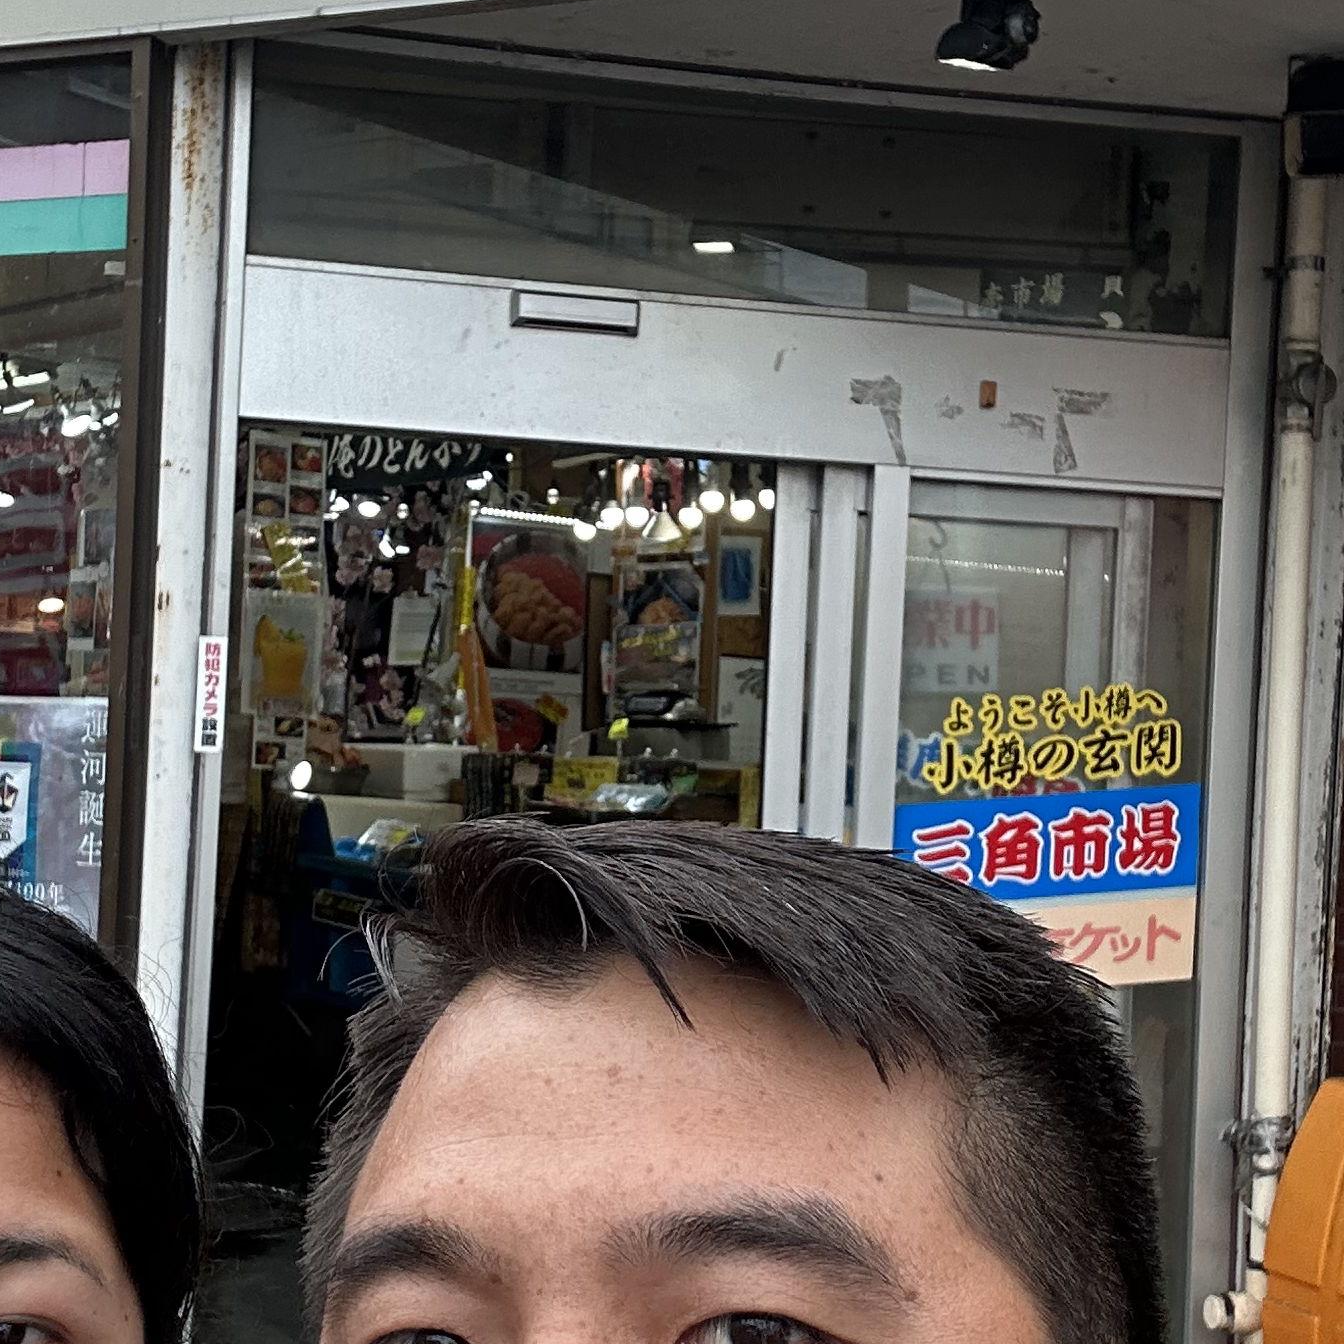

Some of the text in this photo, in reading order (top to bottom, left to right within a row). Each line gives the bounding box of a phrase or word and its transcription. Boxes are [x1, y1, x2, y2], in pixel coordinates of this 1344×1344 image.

[201, 641, 221, 747] 防犯カメラ設置
[946, 686, 1164, 732] ようこそ小樽へ
[76, 710, 108, 867] 運河誕生
[925, 720, 1179, 789] 小樽の玄関
[913, 800, 1180, 888] 三角市場
